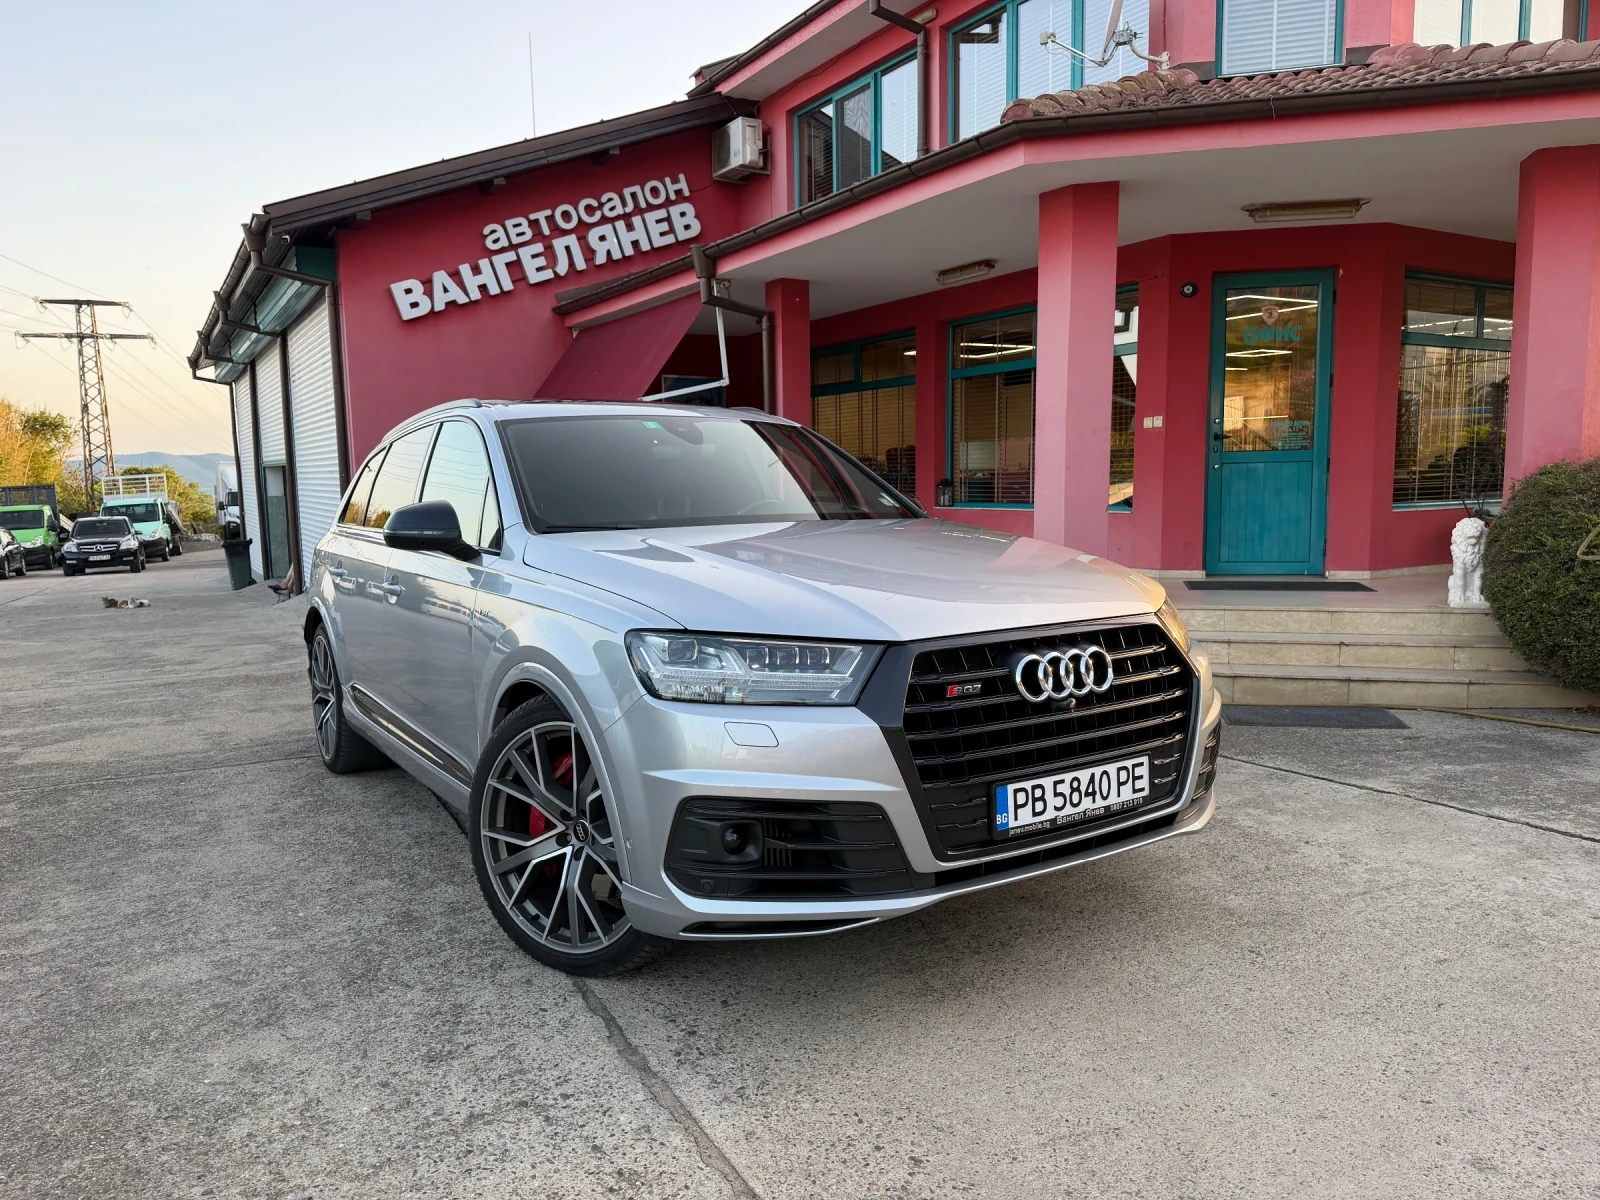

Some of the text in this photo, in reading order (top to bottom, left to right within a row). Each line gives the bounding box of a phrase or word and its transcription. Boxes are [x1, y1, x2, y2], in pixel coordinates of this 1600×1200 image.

[482, 173, 690, 251] автосалон
[389, 202, 701, 321] ВАНГЕЛ ЯНЕВ
[1243, 325, 1302, 344] ОФИС
[1053, 769, 1112, 812] 5840
[996, 812, 1008, 825] BG
[1056, 807, 1105, 825] Вангел Янев
